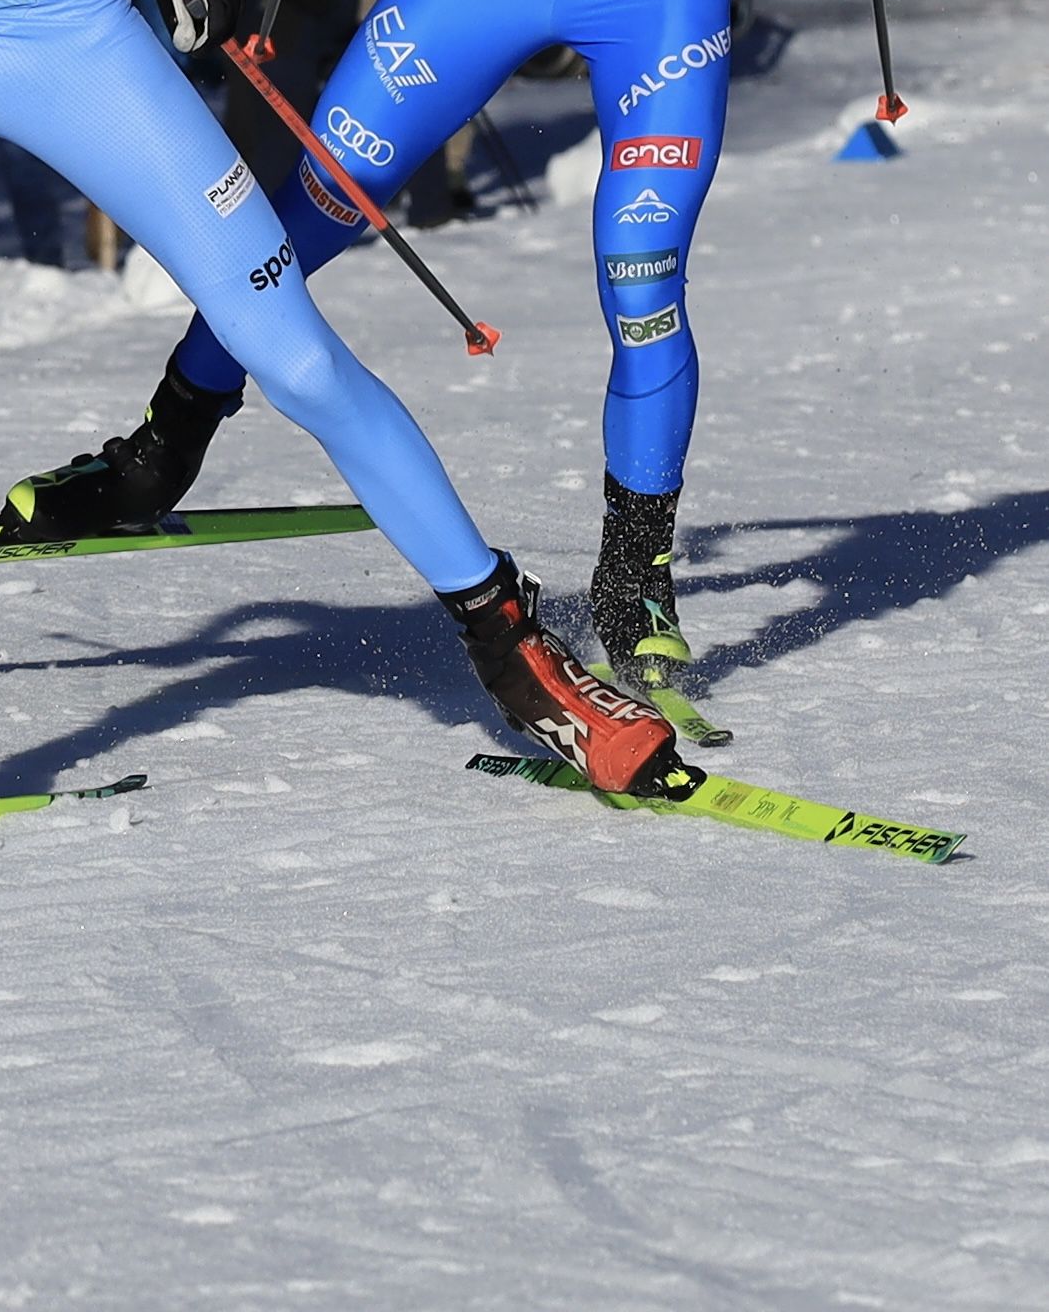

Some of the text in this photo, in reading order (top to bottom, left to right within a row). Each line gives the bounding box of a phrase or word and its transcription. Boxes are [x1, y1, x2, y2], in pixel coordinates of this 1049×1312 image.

[617, 25, 732, 117] FALCONE
[619, 139, 689, 166] enel
[617, 211, 670, 225] AVIO
[618, 307, 677, 343] FORST
[853, 822, 952, 857] FISCHER
